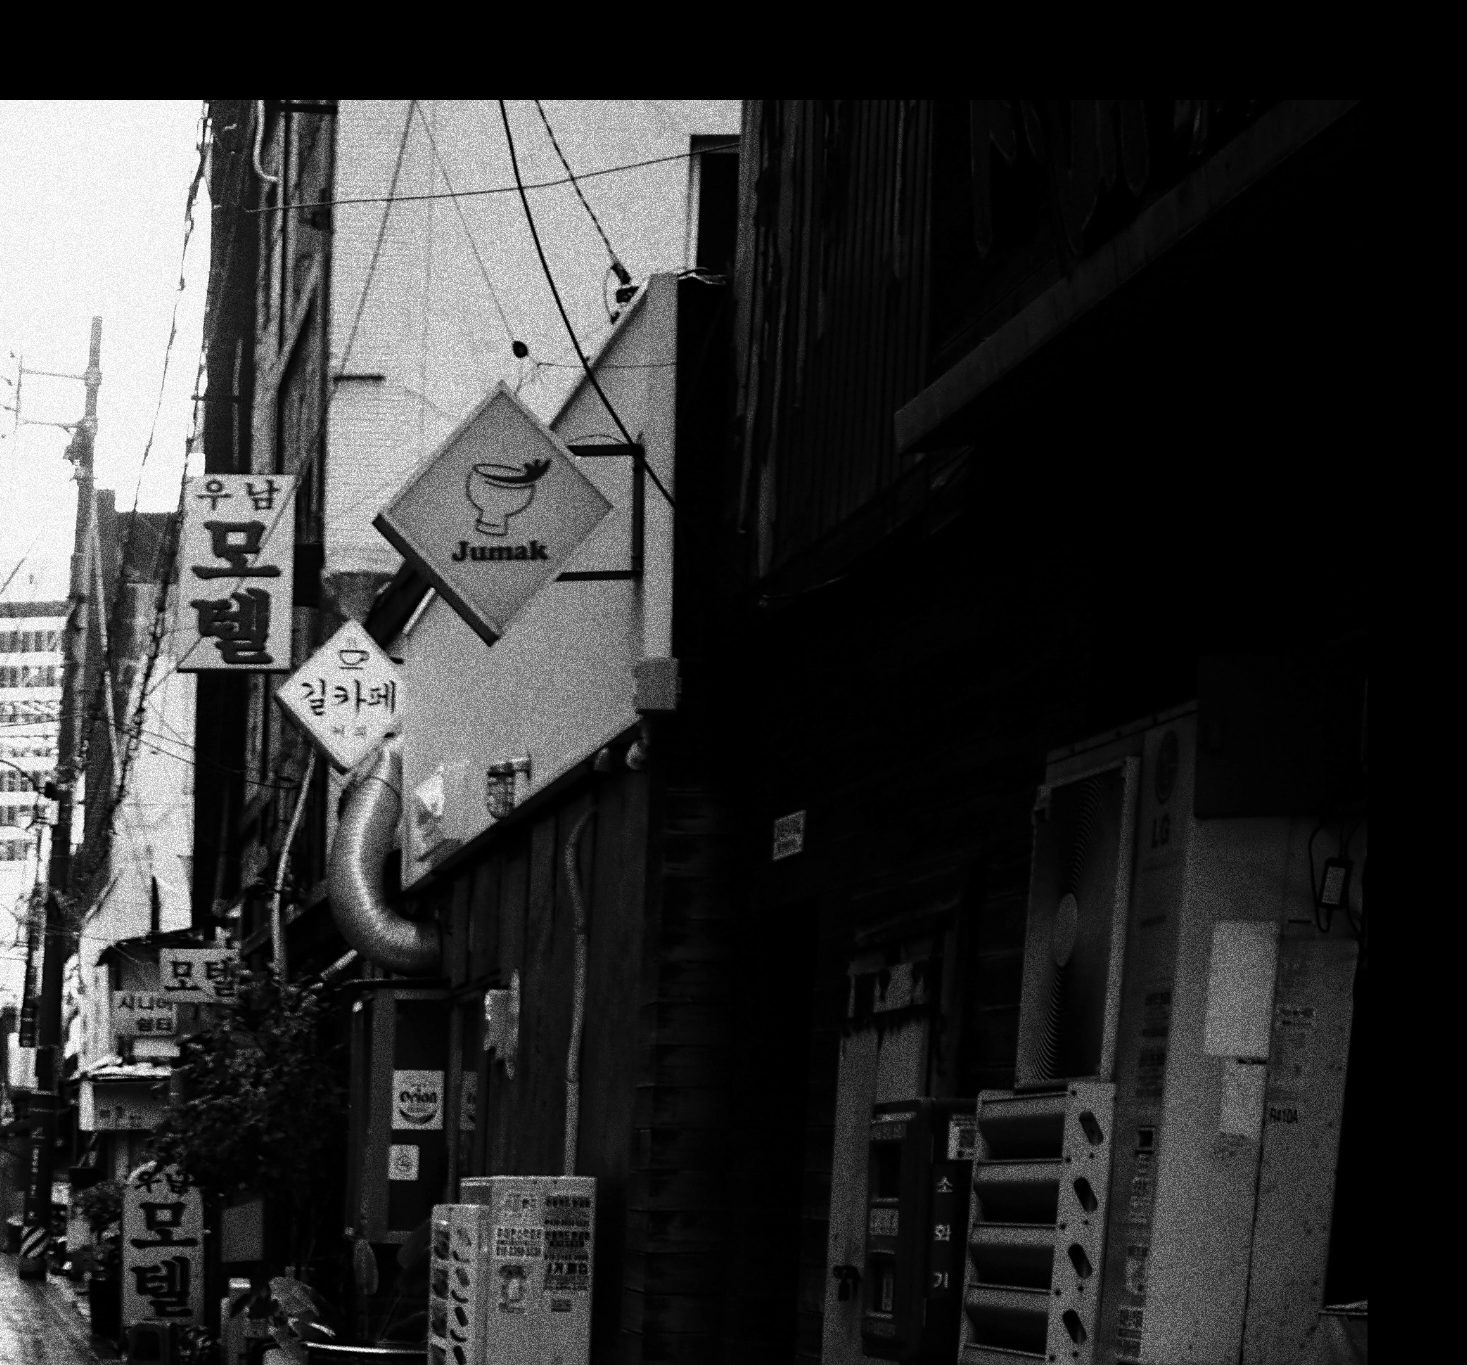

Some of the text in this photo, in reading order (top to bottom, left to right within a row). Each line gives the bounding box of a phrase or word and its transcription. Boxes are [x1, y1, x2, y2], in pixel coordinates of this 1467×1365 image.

[198, 479, 280, 511] 우남
[452, 540, 549, 563] Jumak
[190, 520, 282, 666] 모텔
[301, 677, 397, 717] 길카페
[164, 957, 235, 998] 모텔
[934, 1176, 953, 1289] 소화기
[131, 1202, 199, 1317] 모텔
